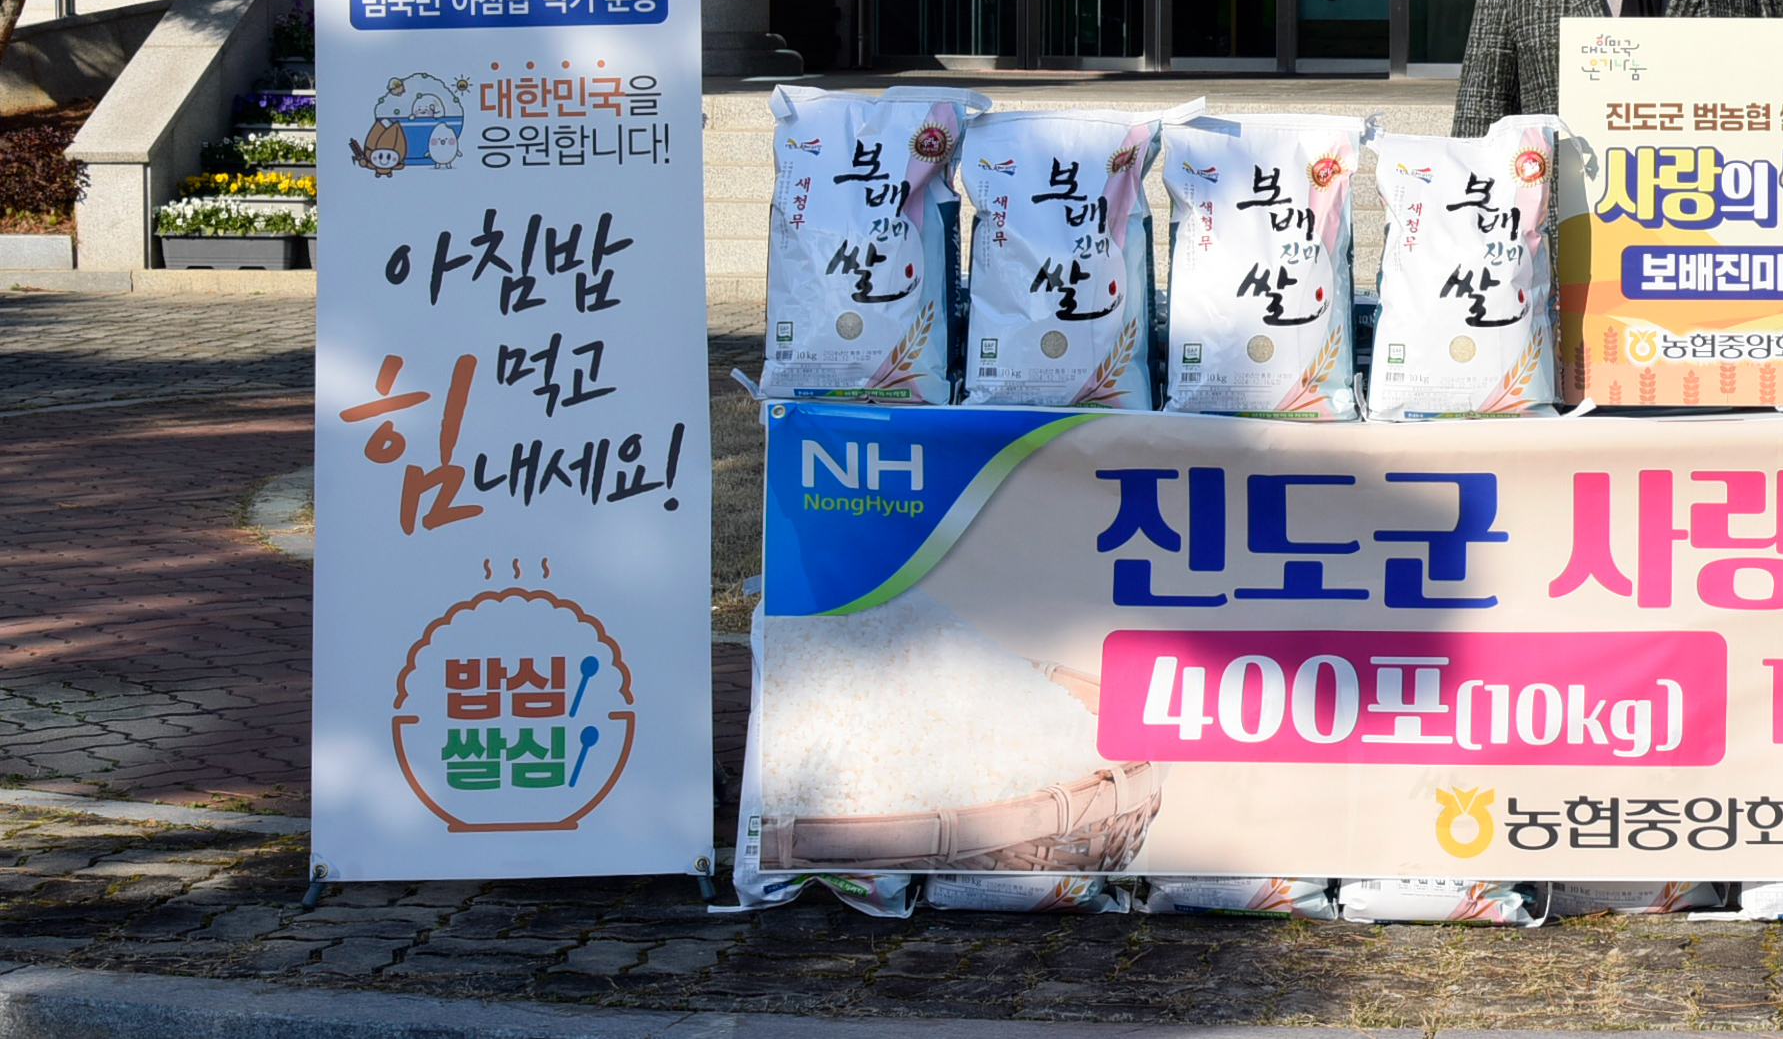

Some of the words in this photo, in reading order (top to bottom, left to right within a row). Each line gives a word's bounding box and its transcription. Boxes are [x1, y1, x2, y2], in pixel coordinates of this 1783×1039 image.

[1580, 33, 1640, 57] 대한민국
[480, 74, 662, 119] 대한민국을
[1607, 103, 1684, 130] 진도군
[1694, 103, 1770, 131] 범농협
[478, 124, 669, 168] 응원합니다!
[833, 139, 910, 217] 보배
[1031, 156, 1107, 234] 보배
[1236, 164, 1315, 241] 보배
[1596, 146, 1775, 226] 사랑의
[870, 218, 909, 241] 진미
[1073, 234, 1110, 259] 진미
[1280, 242, 1320, 265] 진미
[1484, 242, 1523, 265] 진미
[386, 209, 633, 315] 아침밥
[825, 240, 920, 303] 쌀
[1029, 257, 1123, 320] 쌀
[1236, 262, 1329, 326] 쌀
[1439, 264, 1530, 327] 쌀
[497, 333, 616, 417] 먹고
[339, 354, 484, 535] 힘
[473, 422, 686, 512] 내세요!
[801, 440, 924, 492] NH
[804, 493, 924, 517] NongHyup
[1095, 466, 1509, 610] 진도군
[444, 655, 567, 720] 밥심
[1142, 654, 1684, 757] 400포(10kg)
[441, 725, 567, 790] 쌀심
